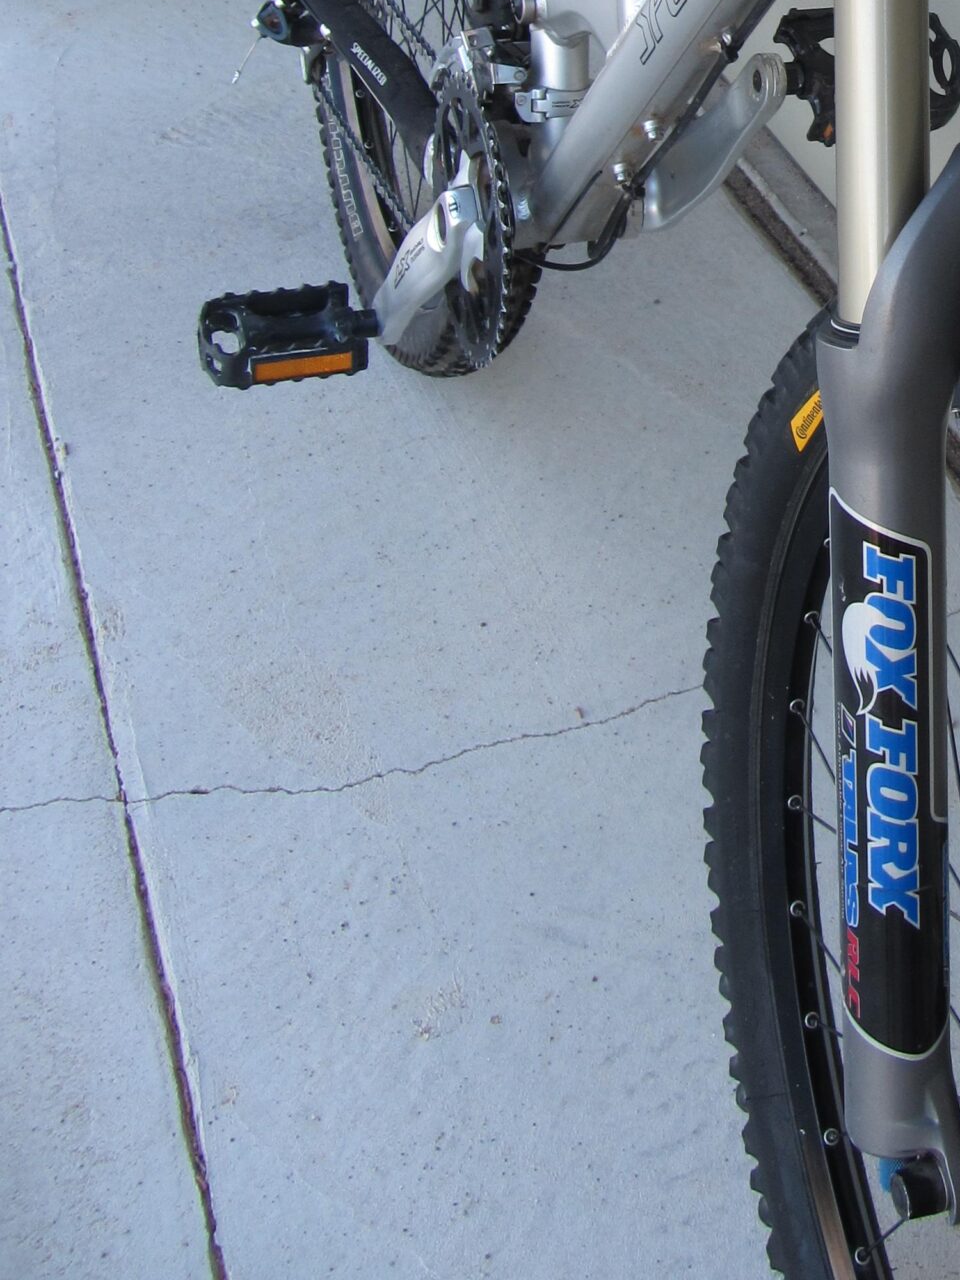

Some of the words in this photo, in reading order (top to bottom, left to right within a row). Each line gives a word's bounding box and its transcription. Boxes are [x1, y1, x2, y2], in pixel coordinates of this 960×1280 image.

[350, 41, 387, 86] SPECIALIZED
[860, 541, 918, 711] FOX
[842, 749, 860, 927] TALAS
[865, 713, 920, 930] FORX
[848, 927, 861, 1019] RLC
